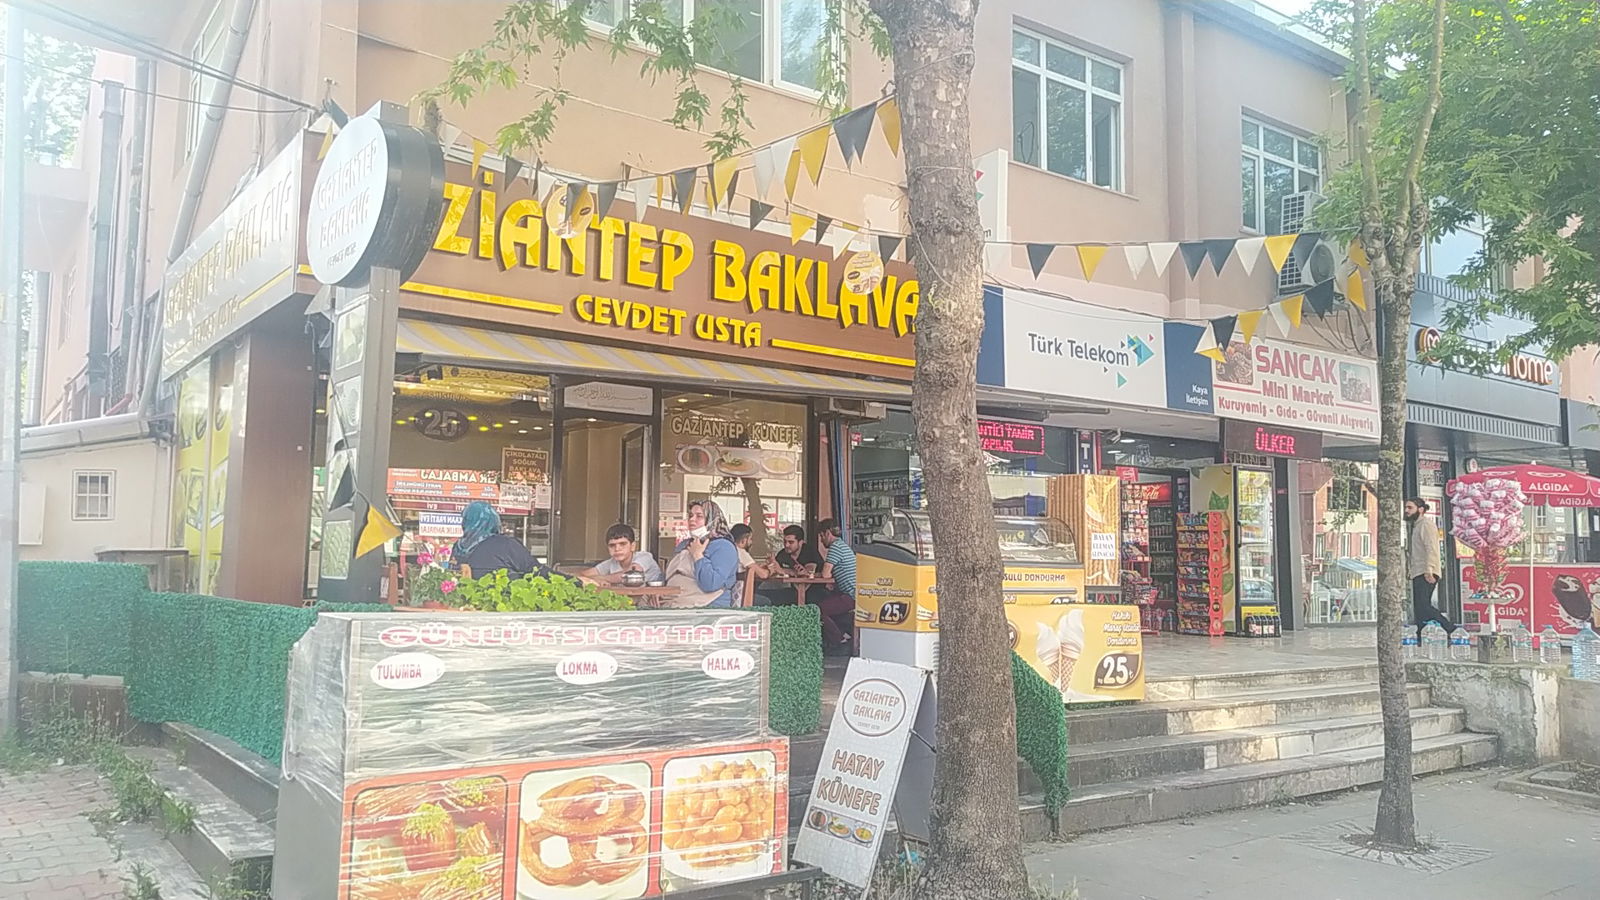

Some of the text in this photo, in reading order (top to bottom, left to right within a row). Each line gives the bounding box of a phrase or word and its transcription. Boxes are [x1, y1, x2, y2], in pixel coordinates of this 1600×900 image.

[433, 171, 919, 337] ZİANTEP BAKLAVA
[576, 295, 761, 347] CEVDET USTA
[1028, 332, 1129, 366] Türk Telekom
[1255, 345, 1337, 385] SANCAK
[1192, 384, 1208, 395] Kaya
[1262, 380, 1334, 406] Mini Market
[425, 409, 458, 437] 25
[1218, 396, 1267, 416] Kuruyemiş
[1276, 405, 1297, 419] Gıda
[1306, 409, 1338, 425] Güvenli
[672, 415, 798, 441] GAZİANTEP KÜNEFE
[1255, 427, 1296, 454] ÜLKER
[1024, 574, 1066, 583] DONDURMA
[884, 603, 900, 621] 25
[379, 622, 556, 647] GÜNLÜK
[563, 626, 666, 645] SICAK
[376, 664, 422, 680] TULUMBA
[562, 661, 598, 675] LOKMA
[707, 657, 741, 671] HALKA
[1103, 656, 1129, 685] 25
[853, 689, 900, 708] GAZİANTEP
[853, 704, 892, 722] BAKLAVA
[832, 749, 885, 781] HATAY
[817, 776, 882, 815] KÜNEFE
